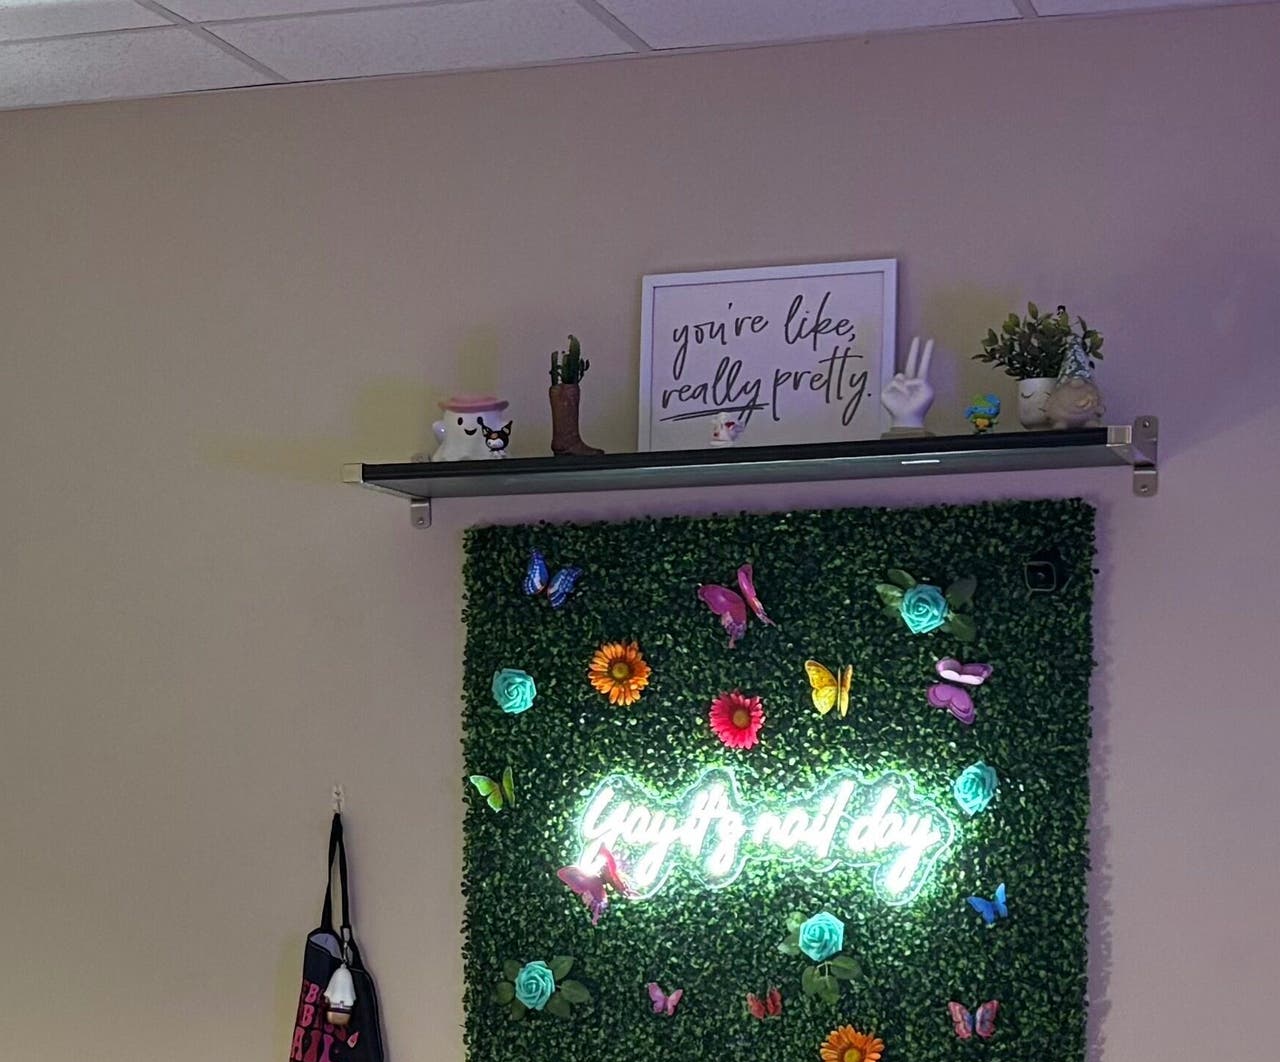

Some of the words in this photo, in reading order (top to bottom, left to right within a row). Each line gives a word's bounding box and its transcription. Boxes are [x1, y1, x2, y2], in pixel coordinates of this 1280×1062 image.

[673, 302, 769, 380] you're
[784, 291, 856, 351] like,
[662, 356, 762, 426] really
[773, 345, 872, 427] pretty.
[754, 779, 854, 858] nail
[847, 785, 941, 894] day
